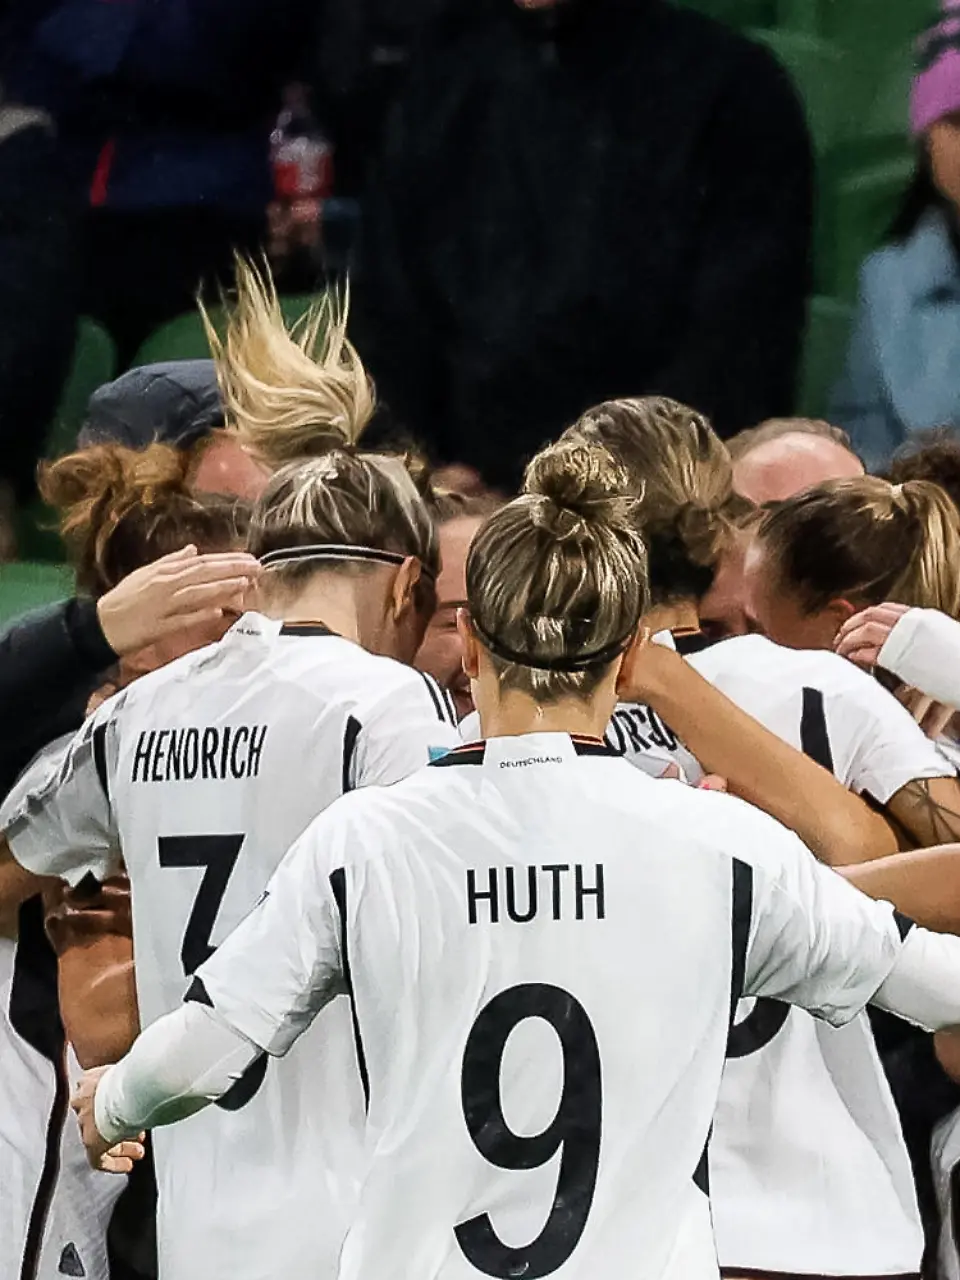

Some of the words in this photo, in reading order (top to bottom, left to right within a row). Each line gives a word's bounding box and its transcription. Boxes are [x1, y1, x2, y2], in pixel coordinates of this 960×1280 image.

[132, 725, 268, 783] HENDRICH
[466, 863, 606, 925] HUTH
[452, 982, 603, 1280] 9
